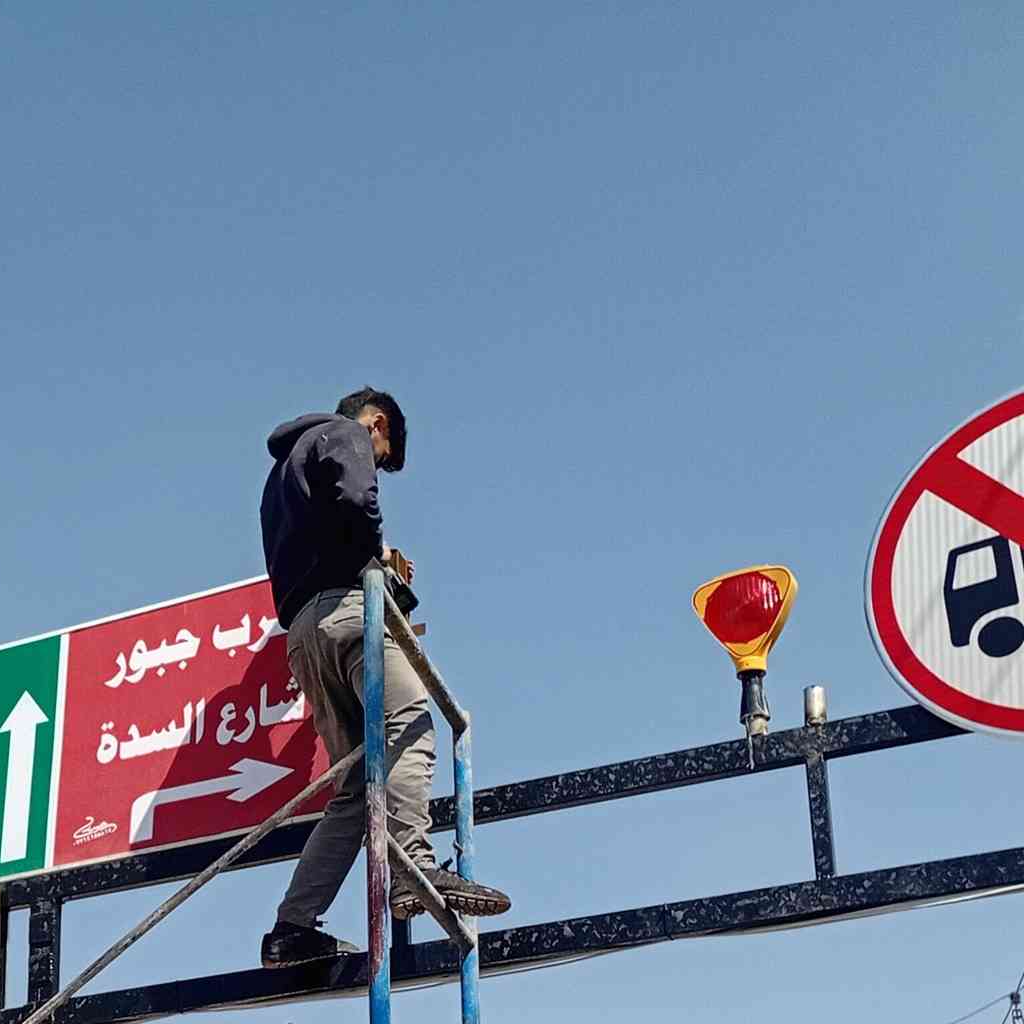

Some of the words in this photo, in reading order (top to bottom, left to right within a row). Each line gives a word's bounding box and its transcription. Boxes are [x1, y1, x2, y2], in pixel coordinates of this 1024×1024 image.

[104, 629, 201, 688] جبور
[212, 613, 290, 658] رب
[97, 697, 206, 764] السدة
[216, 677, 306, 746] شارع
